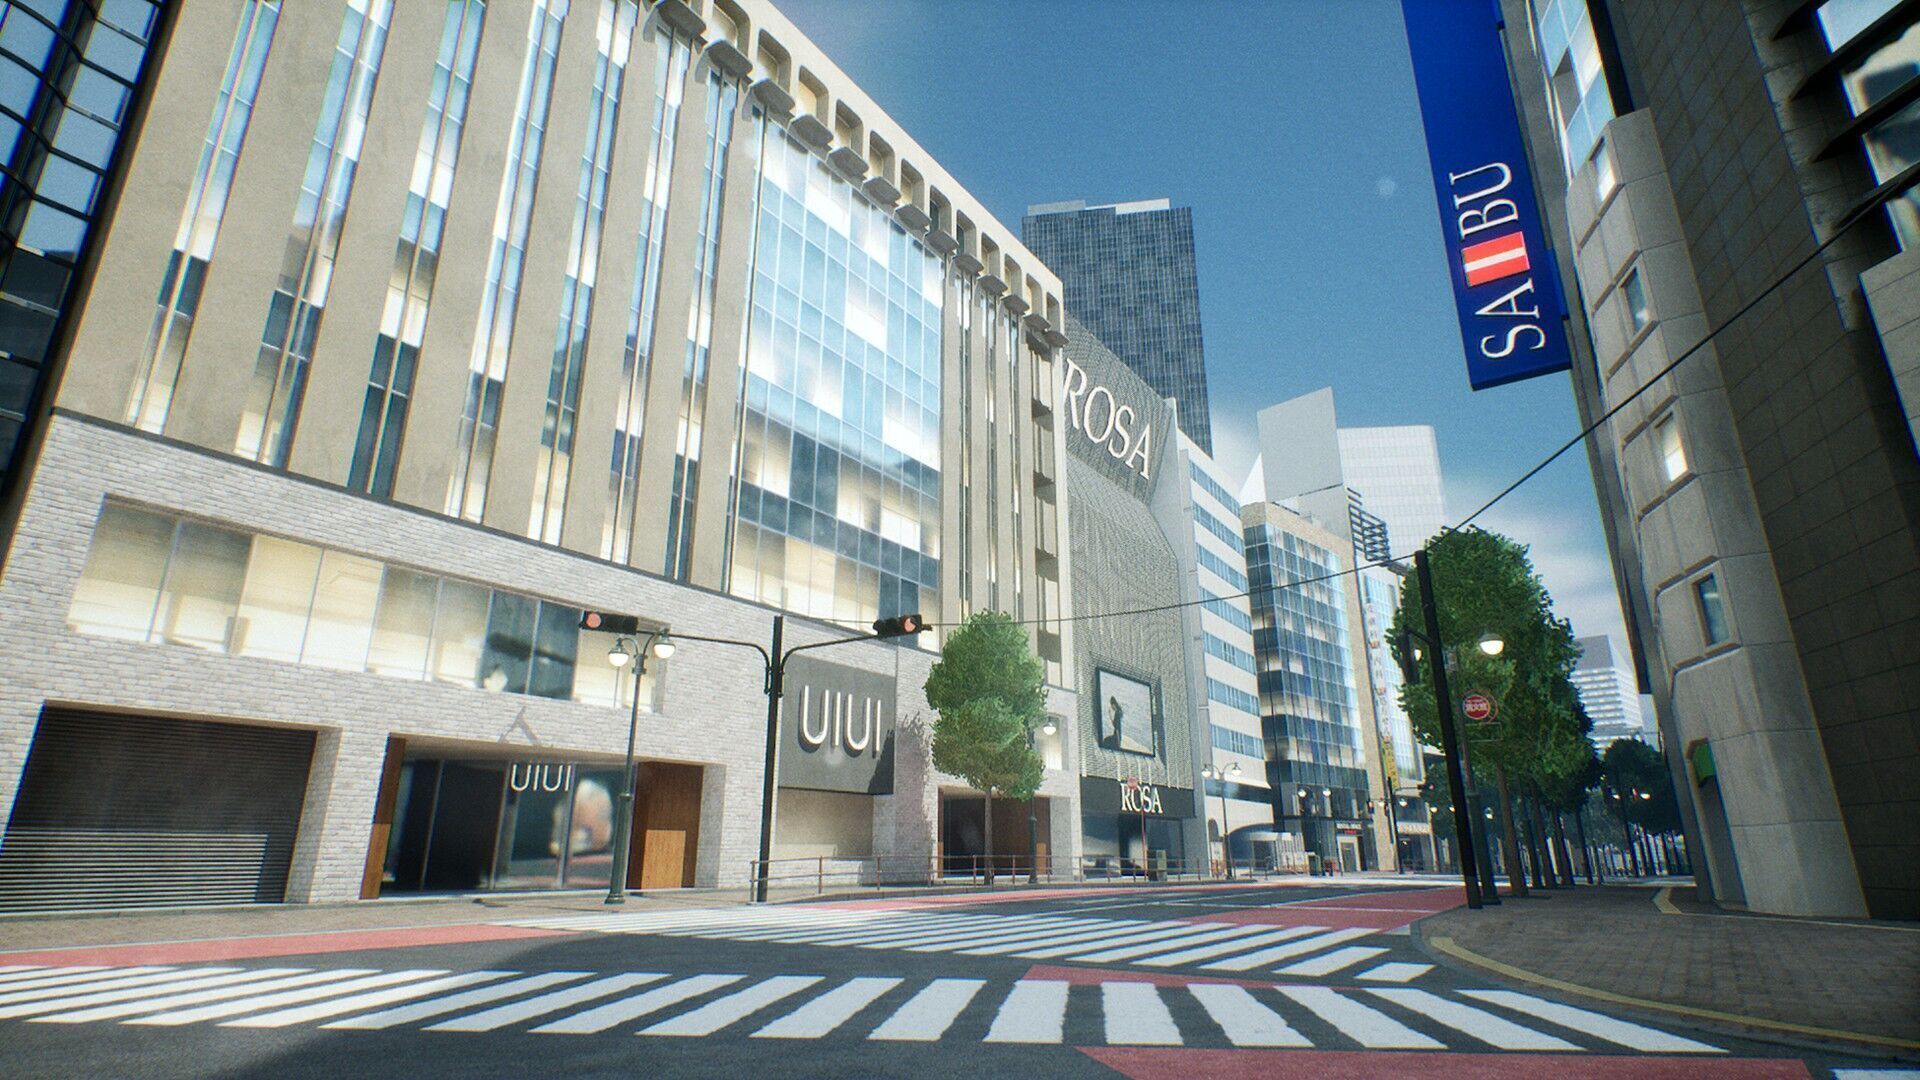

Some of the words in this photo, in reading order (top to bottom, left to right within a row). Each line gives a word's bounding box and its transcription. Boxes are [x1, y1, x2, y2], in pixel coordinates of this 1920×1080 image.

[1064, 358, 1151, 480] ROSA
[803, 684, 882, 752] UIUI
[511, 763, 572, 791] UIUI
[1120, 783, 1163, 814] ROSA
